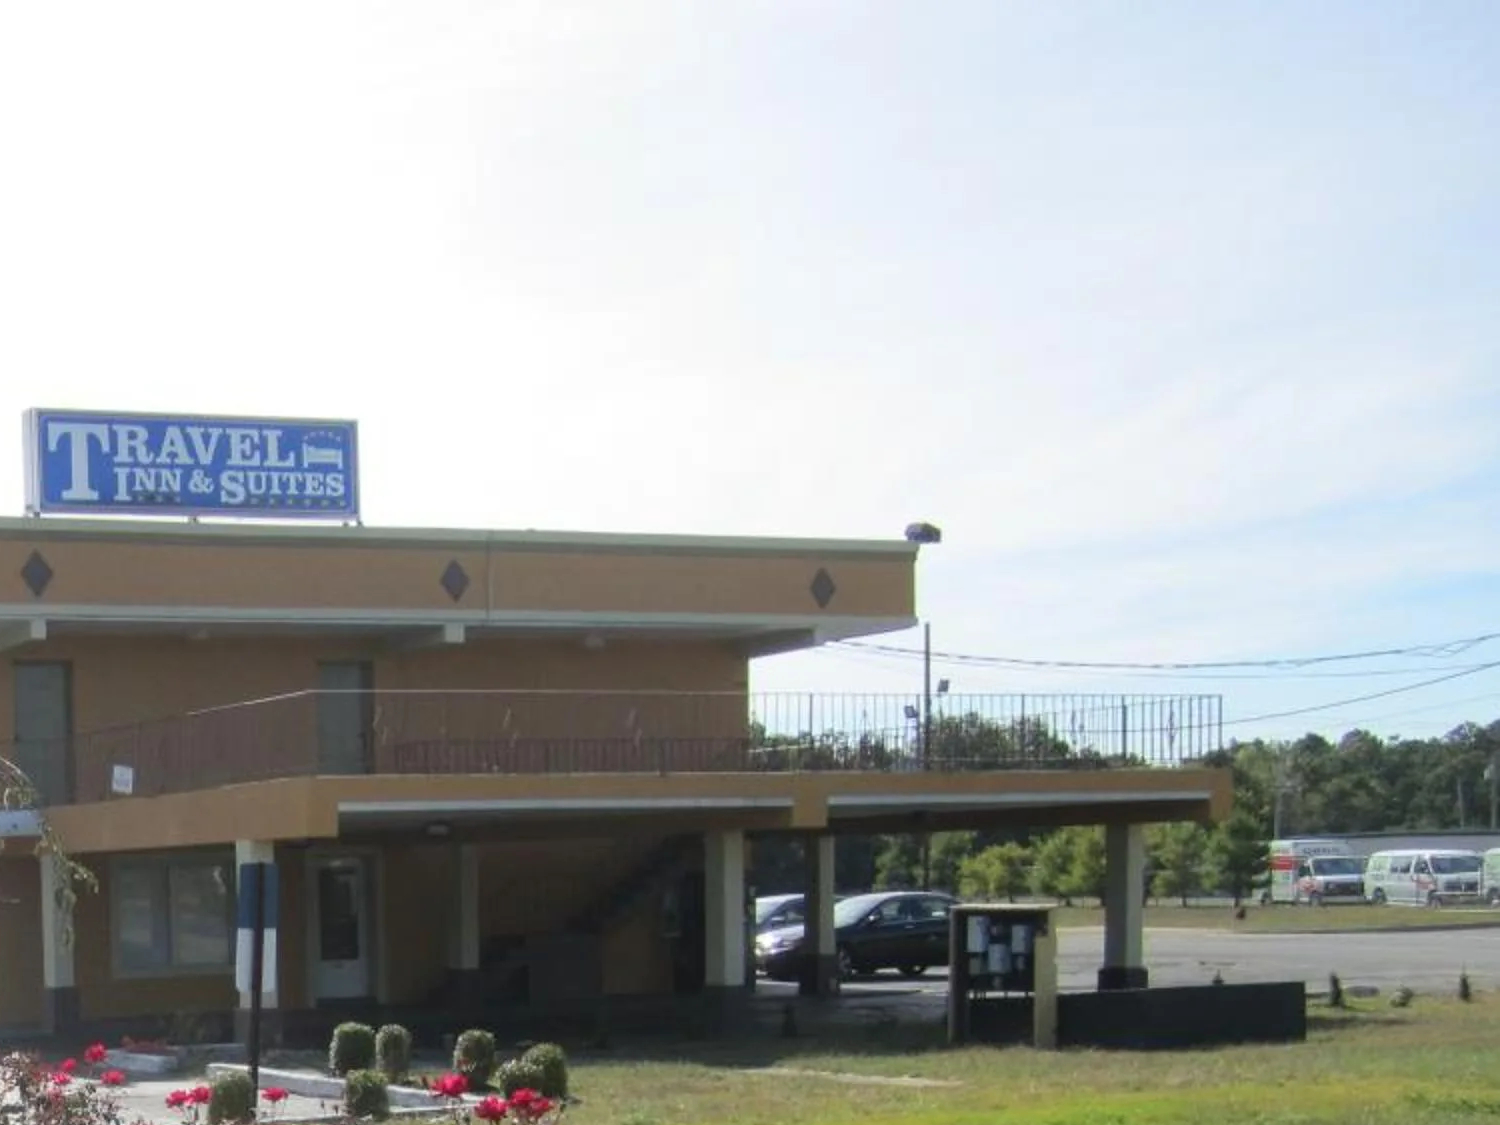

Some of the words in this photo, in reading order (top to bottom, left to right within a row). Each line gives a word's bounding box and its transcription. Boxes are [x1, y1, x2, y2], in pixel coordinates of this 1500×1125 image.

[47, 421, 295, 502] TRAVEL
[113, 466, 182, 502] INN
[188, 470, 215, 494] &
[219, 470, 345, 506] SUITES
